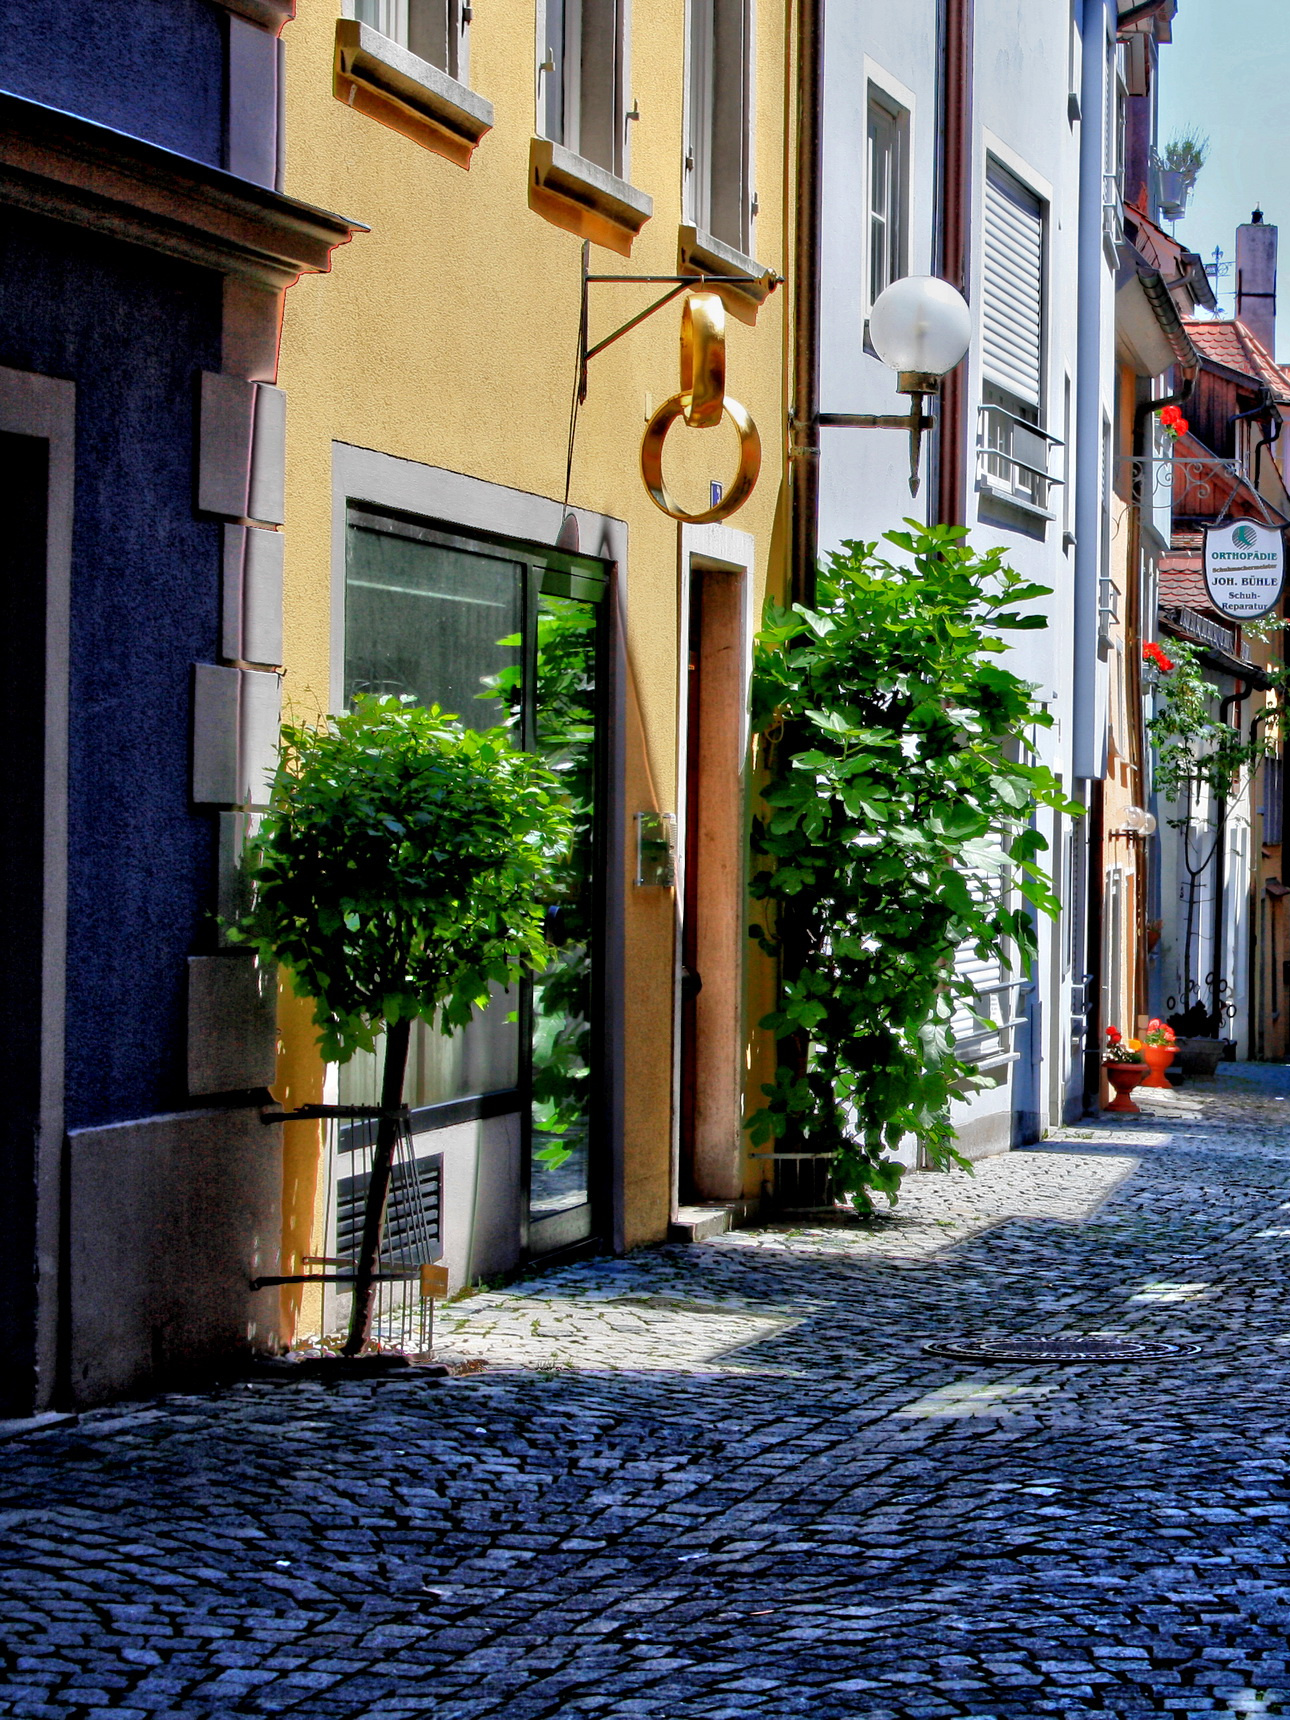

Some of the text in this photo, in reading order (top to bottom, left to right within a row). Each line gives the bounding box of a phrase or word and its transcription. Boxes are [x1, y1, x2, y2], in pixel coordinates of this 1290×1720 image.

[1211, 550, 1278, 561] ORTHOPÄDIE
[1211, 575, 1279, 587] JOH. BÜHLE
[1228, 591, 1261, 600] Schuh-
[1221, 602, 1268, 611] Reparatur
